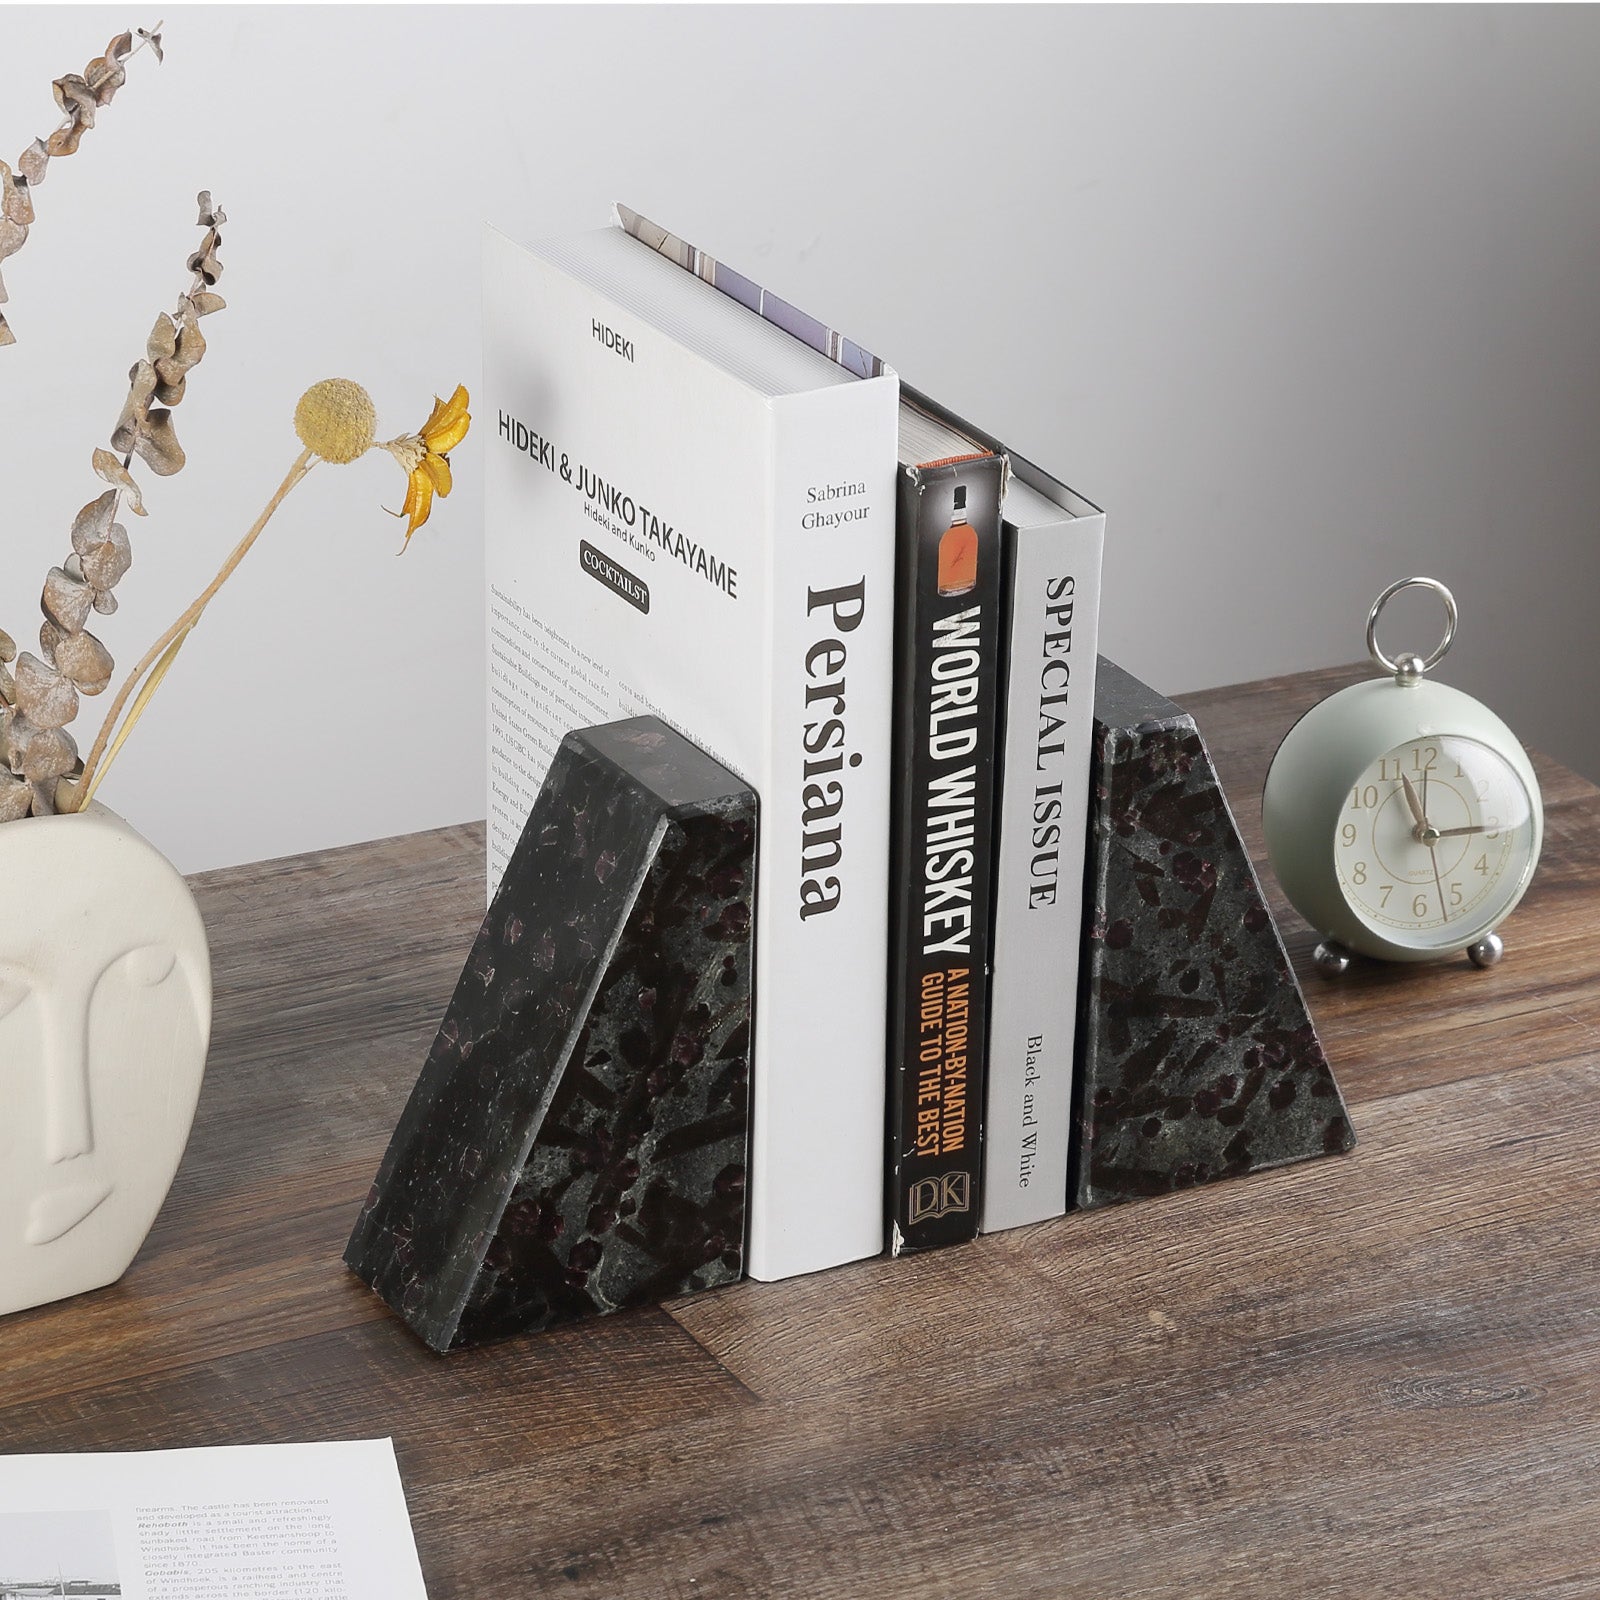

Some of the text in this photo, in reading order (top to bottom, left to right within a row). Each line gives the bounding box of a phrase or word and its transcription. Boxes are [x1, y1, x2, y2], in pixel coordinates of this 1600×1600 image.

[592, 318, 634, 363] HIDEKI
[498, 409, 738, 599] HIDEKI & JUNKO TAKAYAME
[806, 480, 866, 504] Sabrina
[801, 505, 870, 531] Ghayour
[584, 502, 656, 562] Hideki and Kunko
[583, 549, 648, 605] COCKTAILST
[799, 575, 866, 922] Persiana
[1028, 575, 1076, 909] SPECIAL ISSUE
[1378, 758, 1402, 781] 11
[1412, 747, 1438, 771] 12
[923, 605, 982, 955] WORLD WHISKEY
[1351, 785, 1379, 809] 10
[1342, 824, 1357, 847] 9
[1352, 862, 1367, 885] 8
[1474, 853, 1489, 876] 4
[1379, 885, 1394, 908] 7
[1412, 894, 1427, 918] 6
[1450, 883, 1463, 906] 5
[917, 971, 944, 1157] GUIDE TO THE BEST
[942, 967, 970, 1153] A NATION-BY-NATION
[1018, 1033, 1043, 1189] Black and White
[912, 1174, 965, 1219] DK
[138, 1521, 188, 1529] Rehoboth
[157, 1512, 208, 1520] developed
